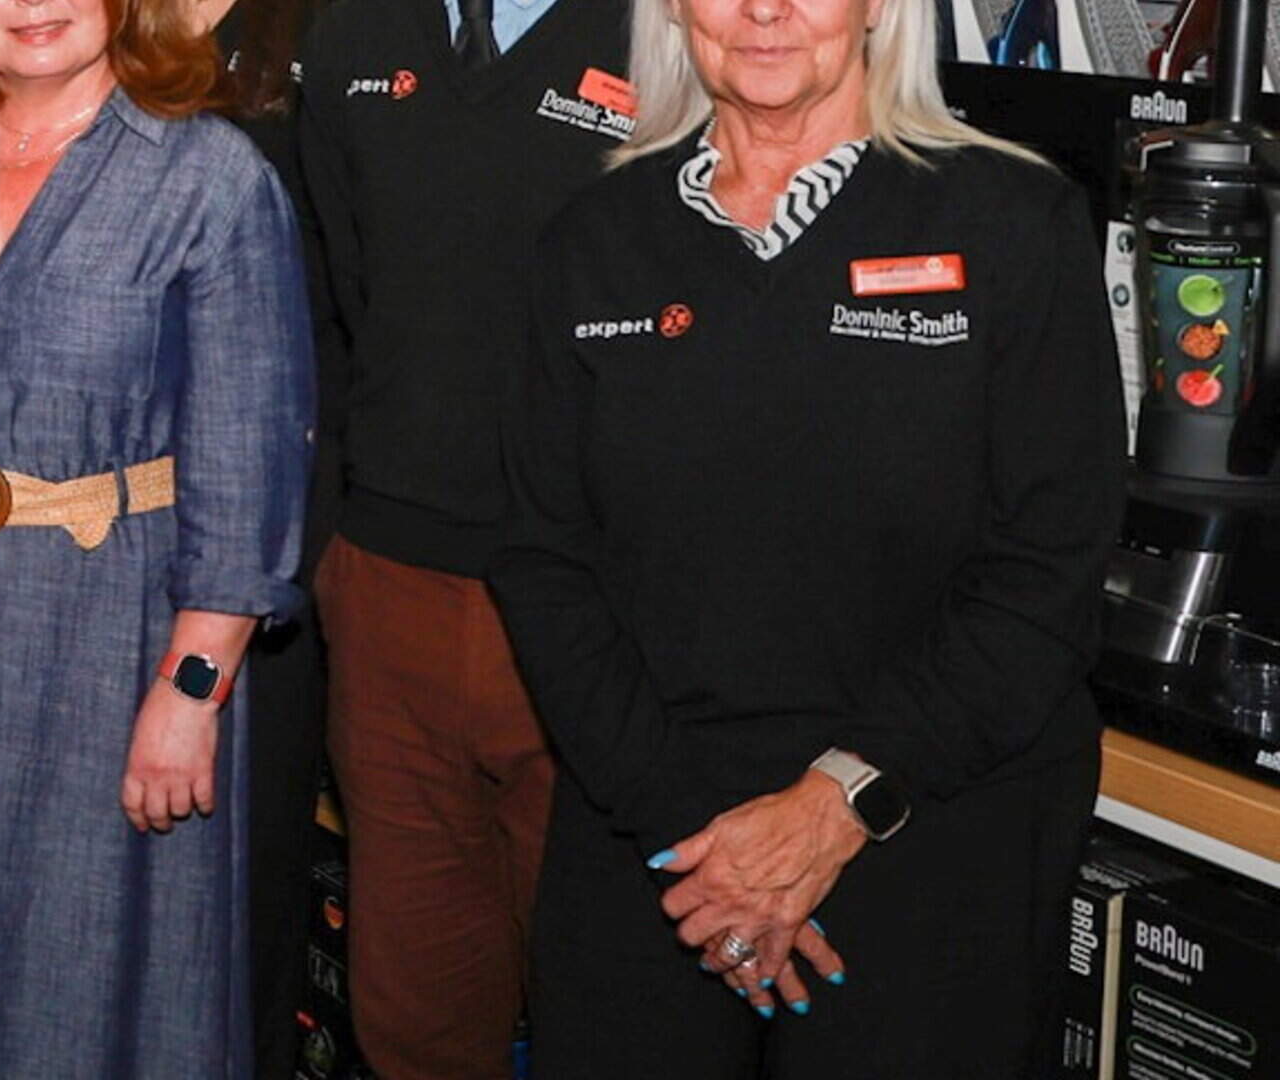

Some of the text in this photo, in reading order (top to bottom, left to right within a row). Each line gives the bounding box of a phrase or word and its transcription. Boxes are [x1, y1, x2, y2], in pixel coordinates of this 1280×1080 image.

[541, 88, 602, 123] Dominic
[1130, 90, 1188, 123] BRAUN
[575, 317, 653, 338] expert
[832, 303, 969, 335] Dominic Smith
[1069, 897, 1099, 976] BRAUN
[1135, 920, 1204, 972] BRAUN
